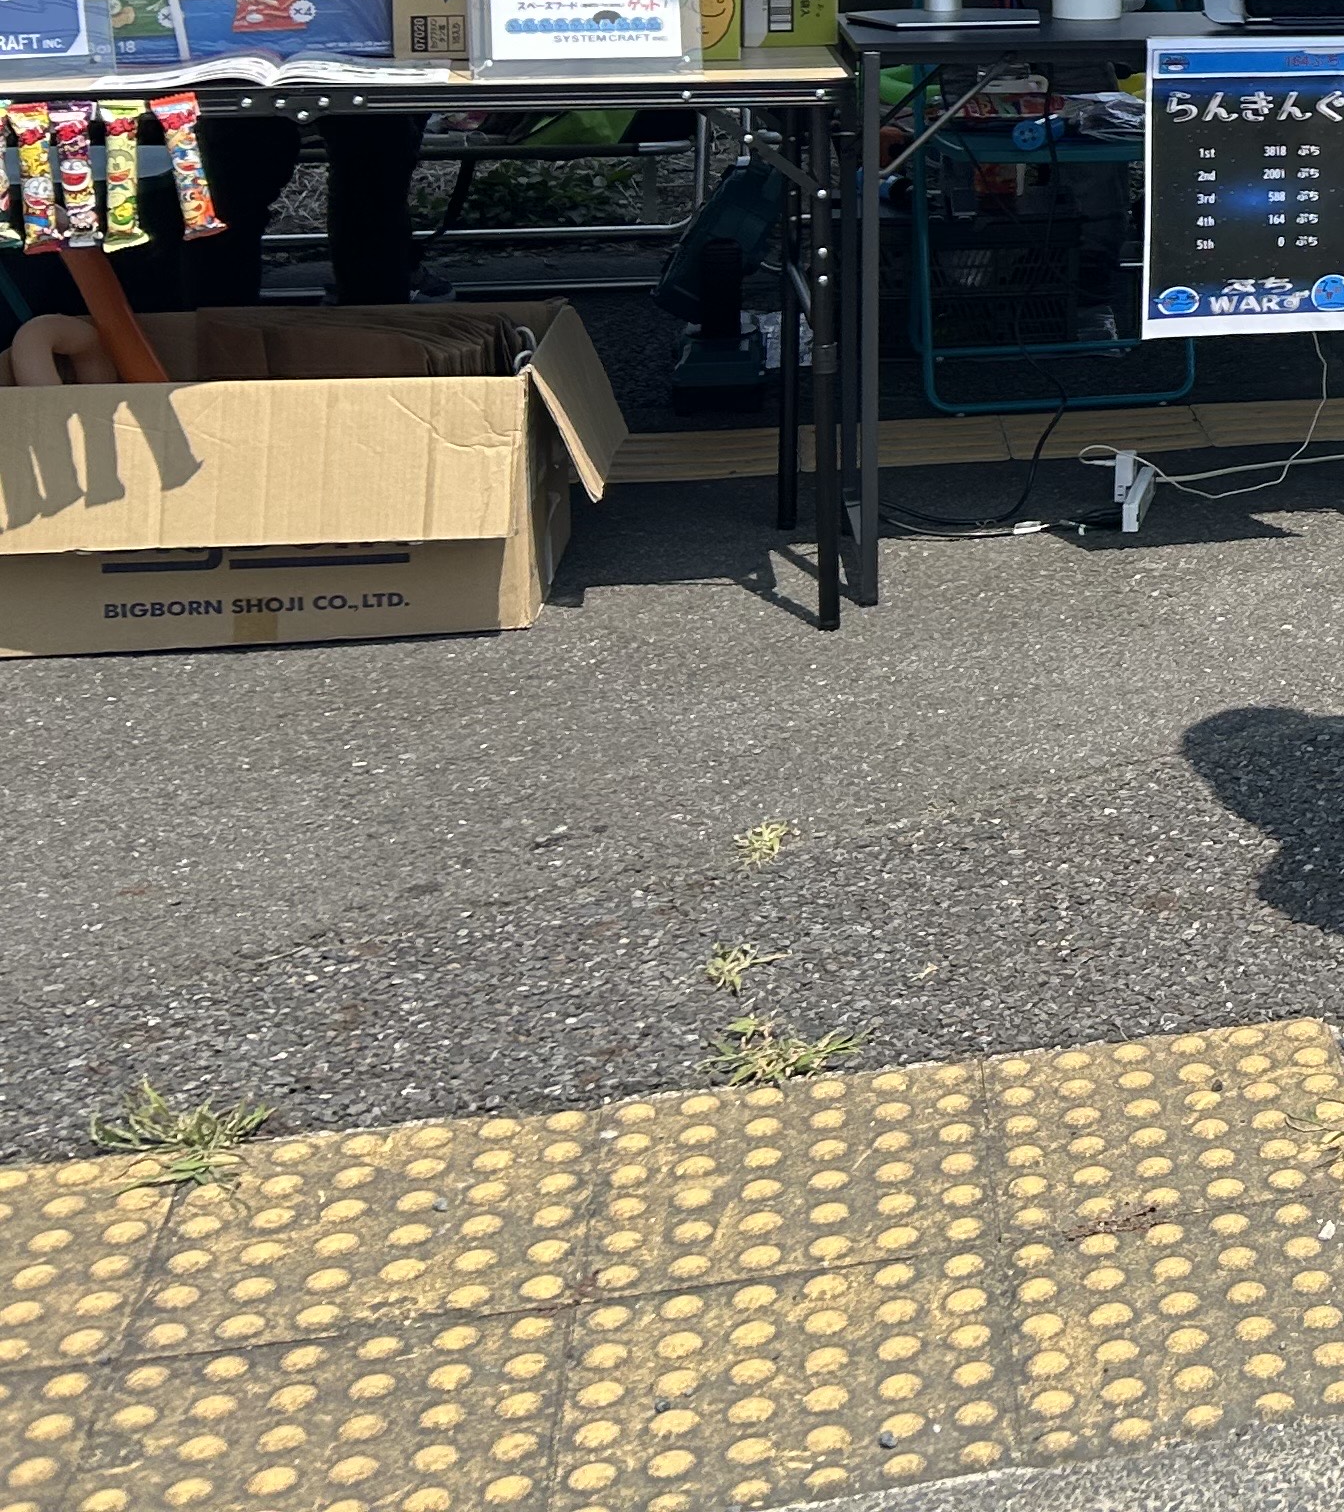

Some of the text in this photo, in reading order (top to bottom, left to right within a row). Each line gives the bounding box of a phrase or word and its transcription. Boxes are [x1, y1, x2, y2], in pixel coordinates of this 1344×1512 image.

[413, 17, 426, 52] 07020
[1199, 147, 1216, 159] 1st
[1263, 146, 1287, 157] 3818
[1197, 170, 1216, 182] 2nd
[1262, 168, 1286, 180] 2001
[1197, 193, 1216, 204] 3rd
[1196, 216, 1215, 227] 4th
[1267, 214, 1286, 225] 164
[1196, 239, 1215, 250] 5th
[1277, 236, 1285, 247] 0
[103, 599, 223, 619] BIGBORN
[231, 596, 304, 615] SHOJI
